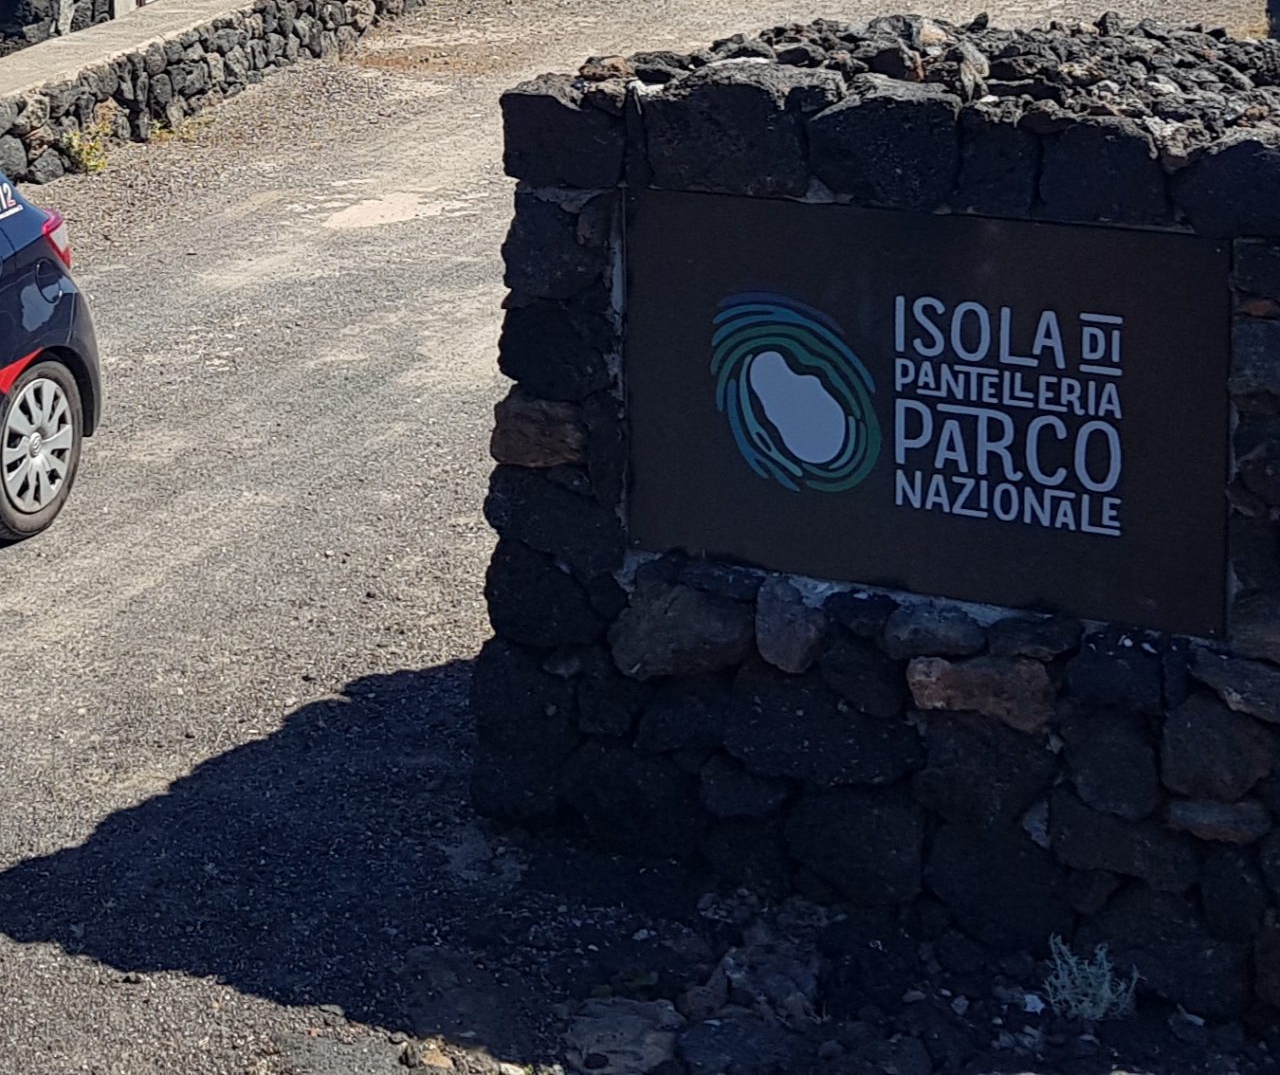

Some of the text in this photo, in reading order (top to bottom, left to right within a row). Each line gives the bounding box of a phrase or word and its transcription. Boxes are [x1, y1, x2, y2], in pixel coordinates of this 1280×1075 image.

[894, 295, 1122, 369] ISOLA DI
[894, 357, 1123, 419] PANTELLERIA
[894, 398, 1122, 492] PARCO
[894, 468, 1122, 537] NAZIONALE
